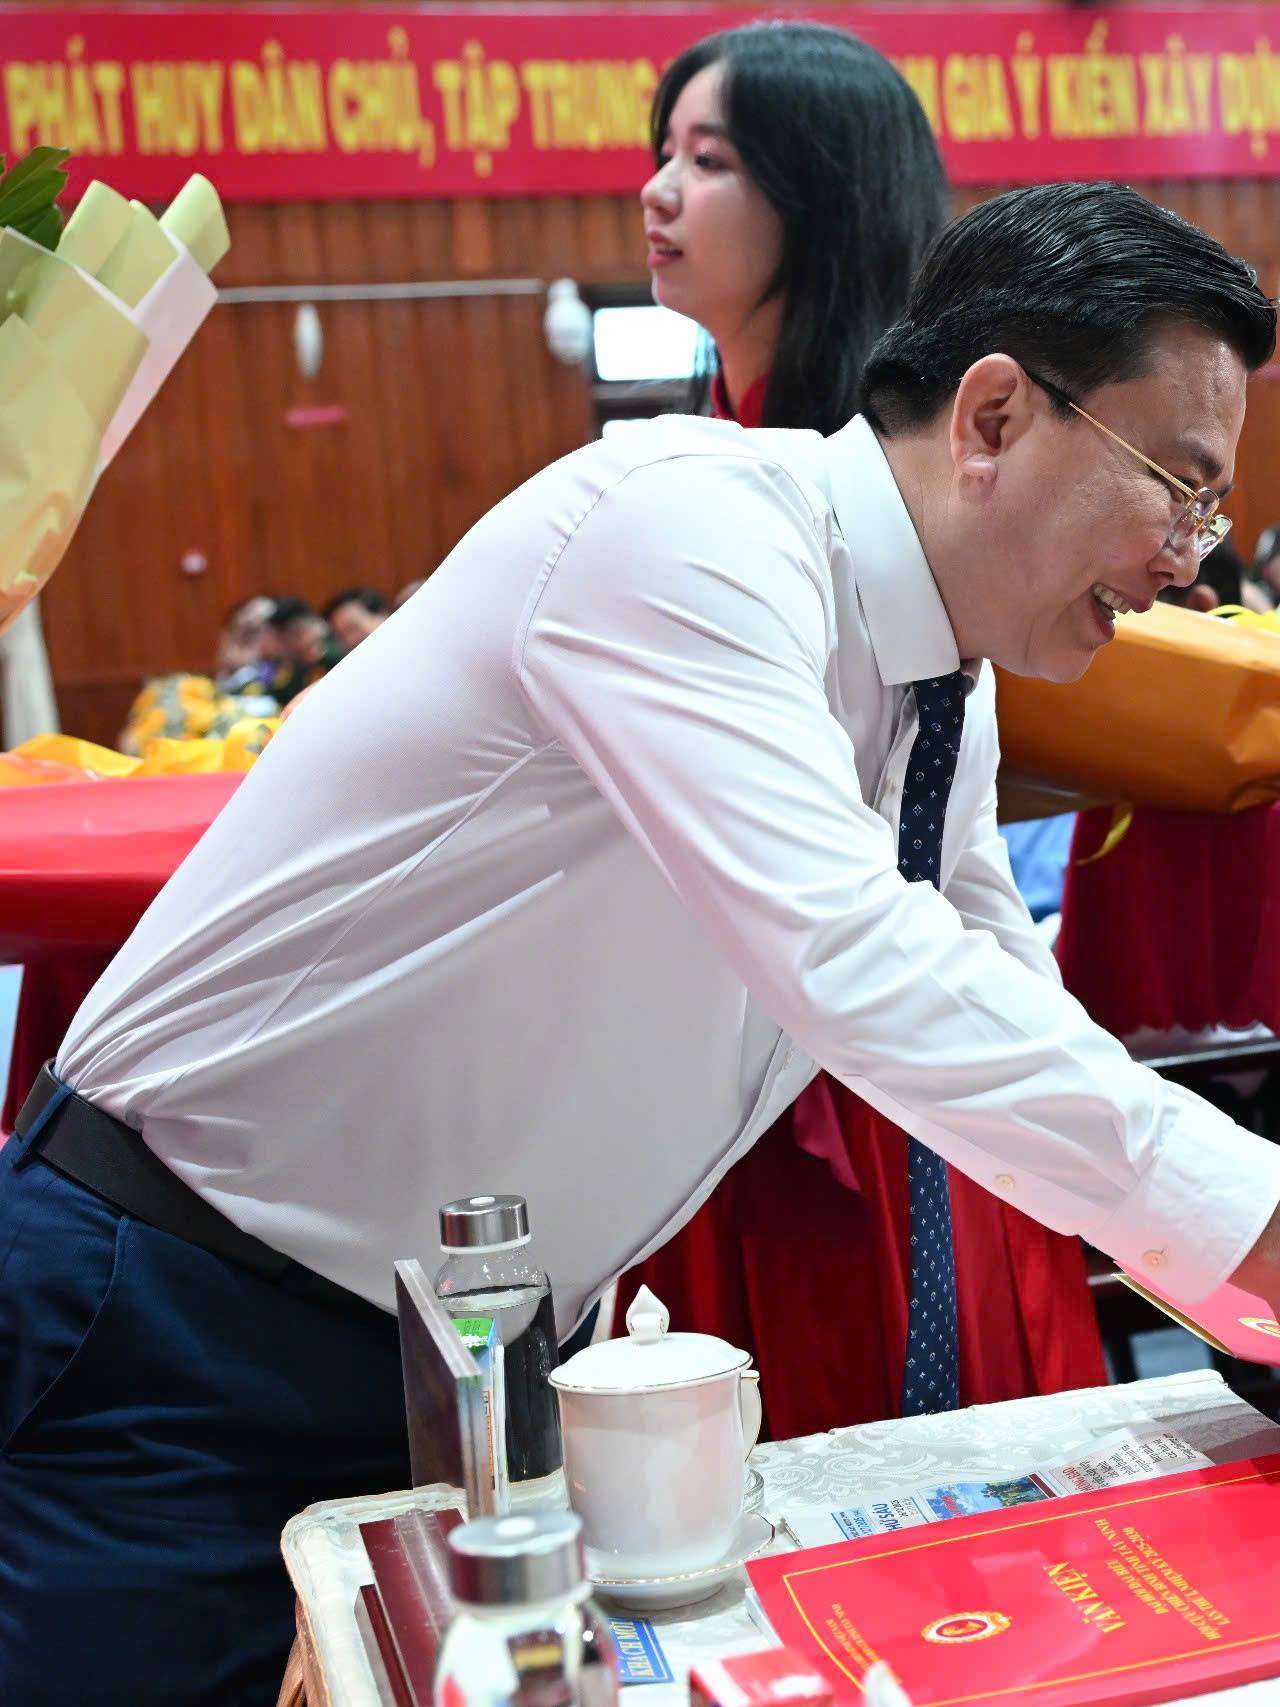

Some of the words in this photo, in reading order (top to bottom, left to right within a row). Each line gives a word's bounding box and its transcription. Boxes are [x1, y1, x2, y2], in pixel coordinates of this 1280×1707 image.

[3, 34, 125, 155] PHÁT
[131, 61, 224, 154] HUY
[234, 40, 329, 153] DÂN
[330, 27, 435, 168] CHỦ,
[433, 41, 519, 176] TẬP
[523, 59, 656, 149] TRUNG
[943, 53, 1012, 141] GIA
[1012, 29, 1043, 139] Ý
[1046, 18, 1139, 138] KIẾN
[1140, 34, 1213, 134] XÂY
[1043, 1560, 1099, 1602] KIỆN
[1082, 1601, 1126, 1633] VĂN
[618, 1641, 654, 1676] KHÁCH
